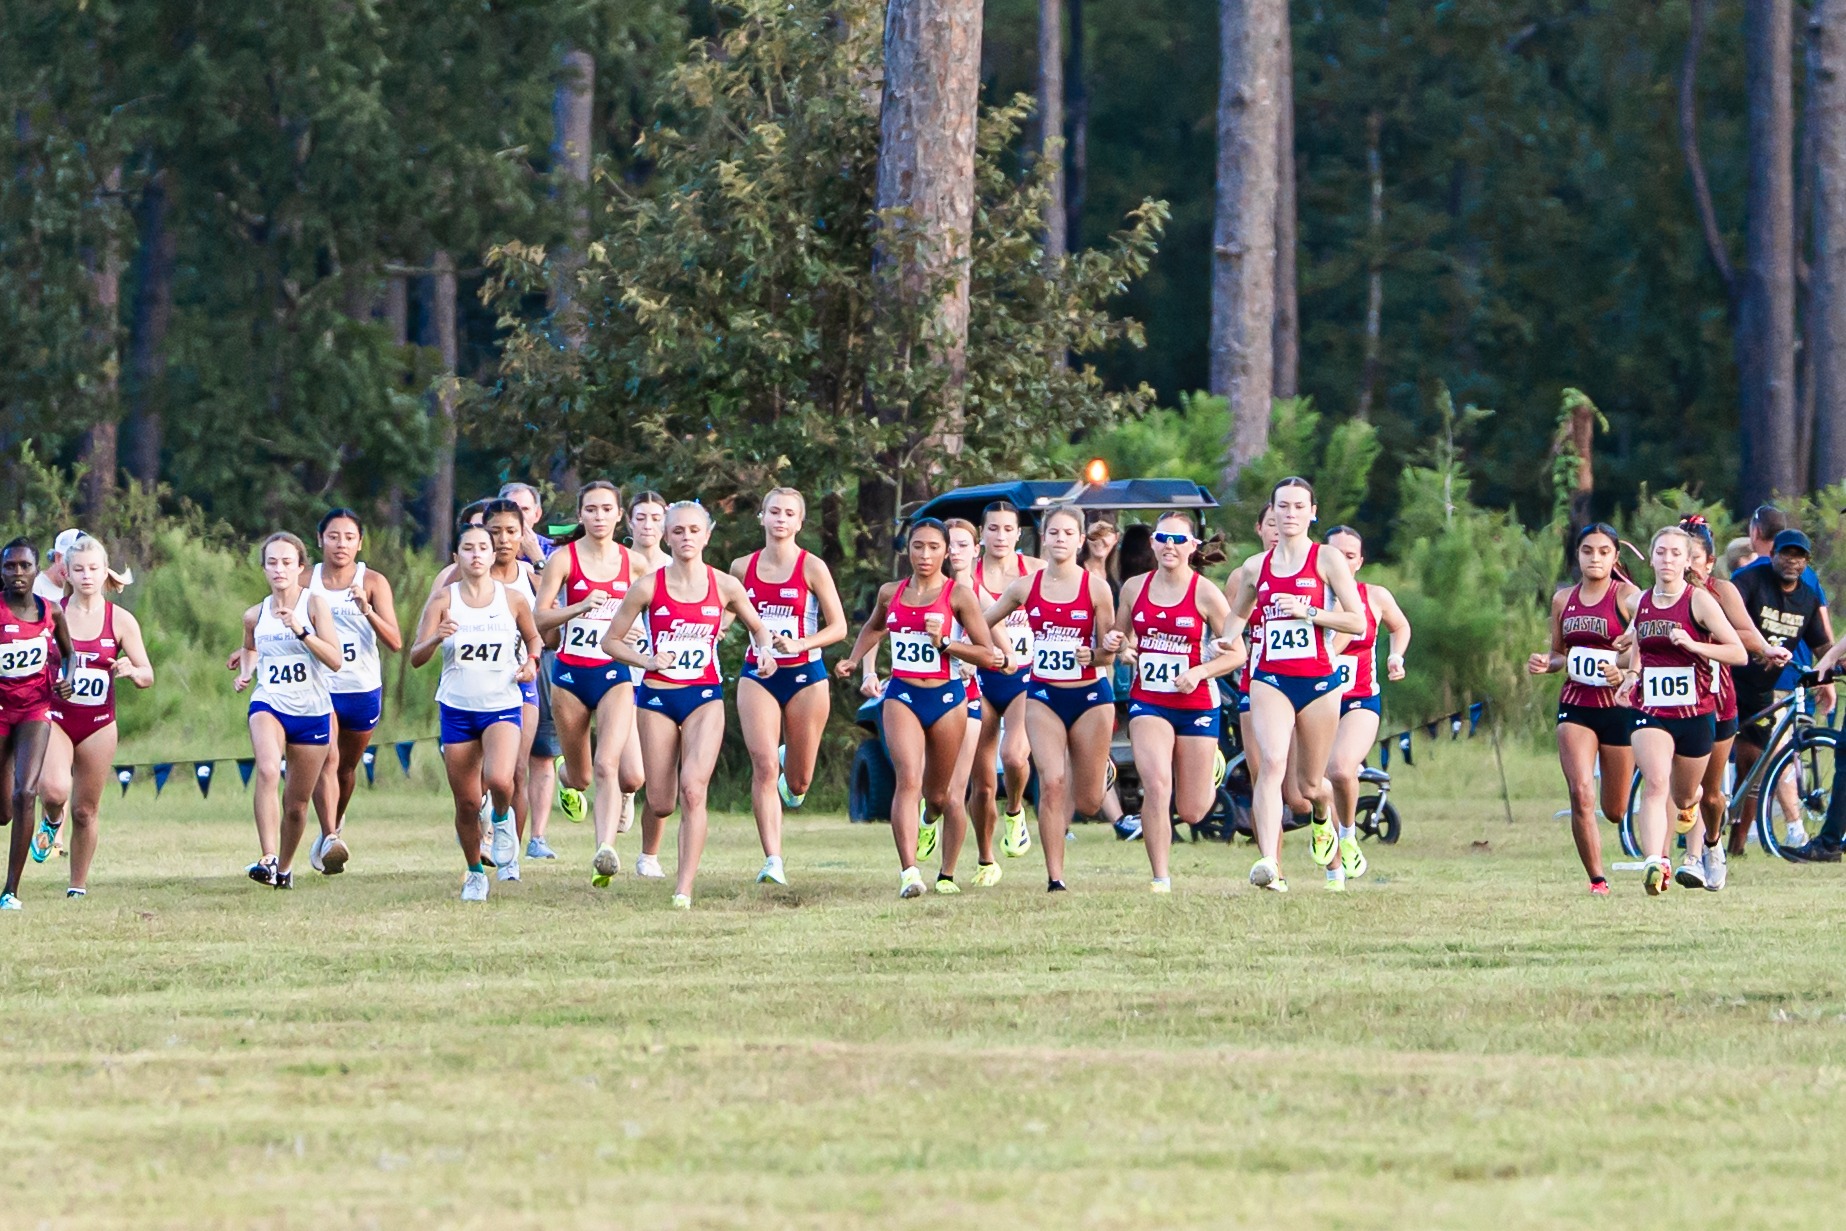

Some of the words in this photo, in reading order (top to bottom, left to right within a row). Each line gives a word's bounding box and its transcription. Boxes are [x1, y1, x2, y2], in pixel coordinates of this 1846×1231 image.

[458, 624, 485, 632] PRING
[487, 623, 510, 632] HILL
[571, 626, 601, 648] 24
[1639, 620, 1682, 640] COAST
[1270, 628, 1309, 650] 243
[2, 647, 42, 670] 322
[460, 643, 502, 662] 247
[895, 641, 935, 663] 236
[1038, 649, 1075, 671] 235
[269, 662, 307, 684] 248
[1144, 661, 1181, 683] 241
[1649, 676, 1689, 697] 105
